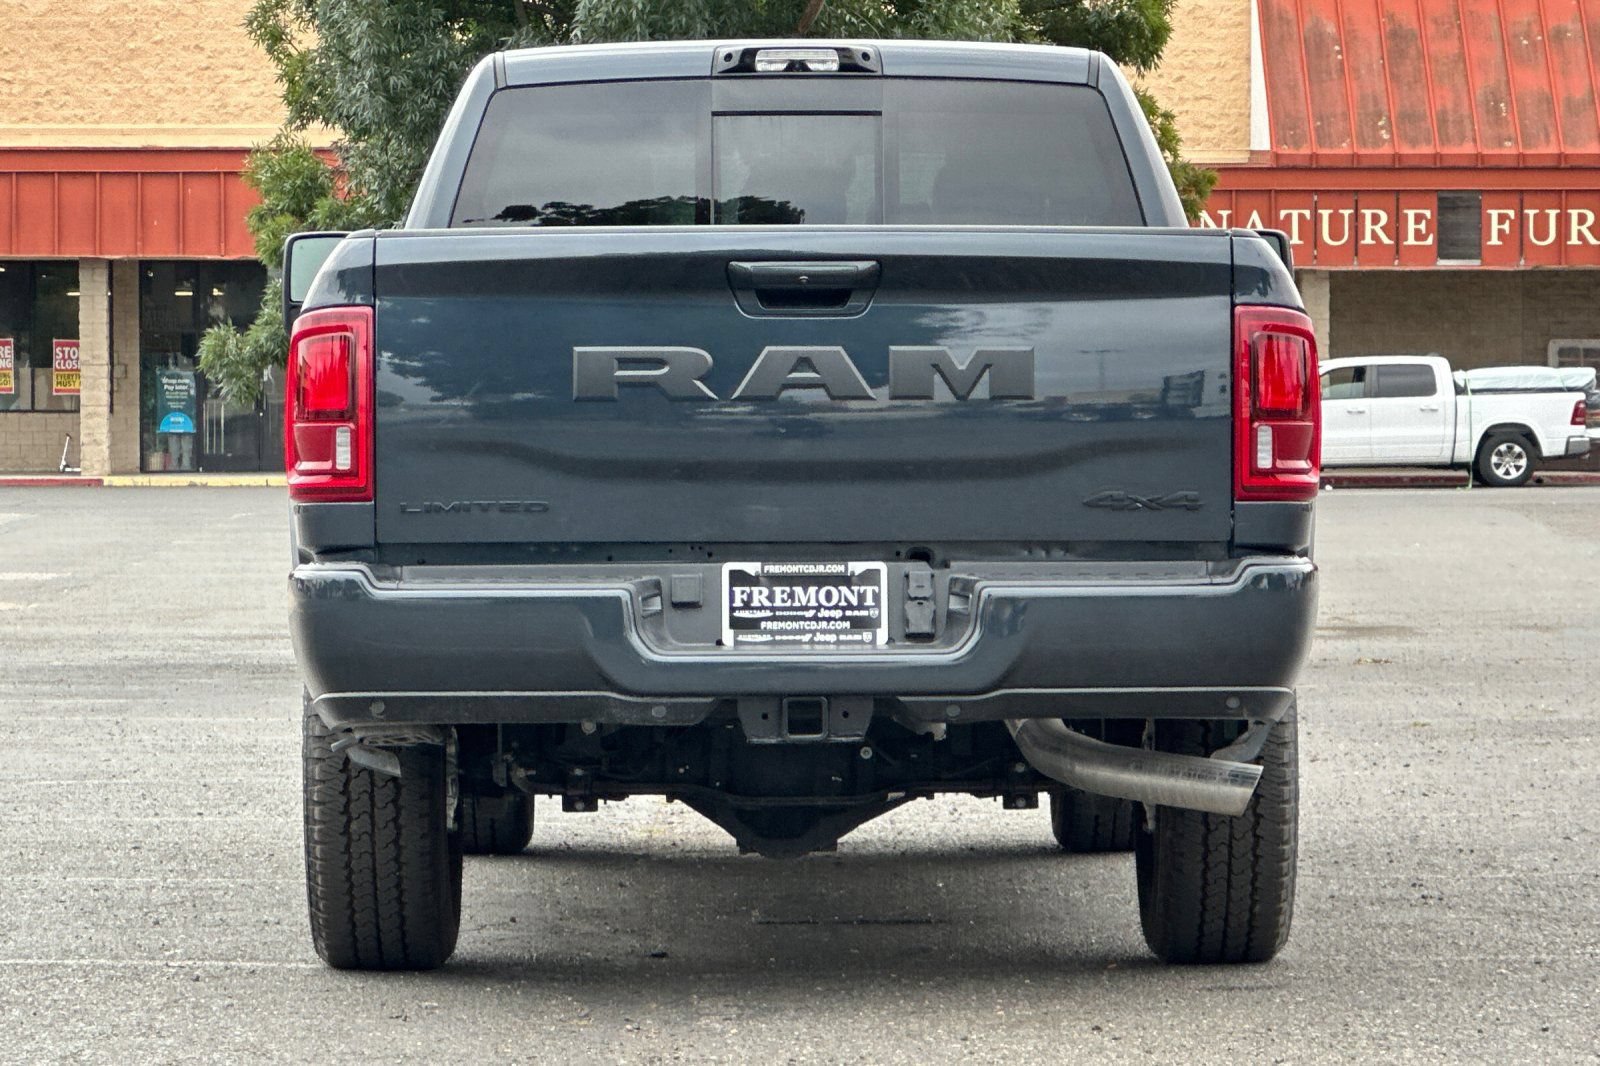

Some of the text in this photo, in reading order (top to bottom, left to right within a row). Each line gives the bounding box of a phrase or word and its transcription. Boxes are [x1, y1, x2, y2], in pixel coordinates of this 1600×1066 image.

[1486, 209, 1600, 246] FUR
[573, 346, 1035, 401] RAM
[400, 501, 549, 513] LIMITED
[763, 564, 845, 574] FREMONTCDJR.COM
[732, 586, 880, 607] FREMONT
[817, 608, 843, 619] Jeep
[760, 621, 851, 630] FREMONTCDJR.COM
[813, 632, 838, 643] Jeep
